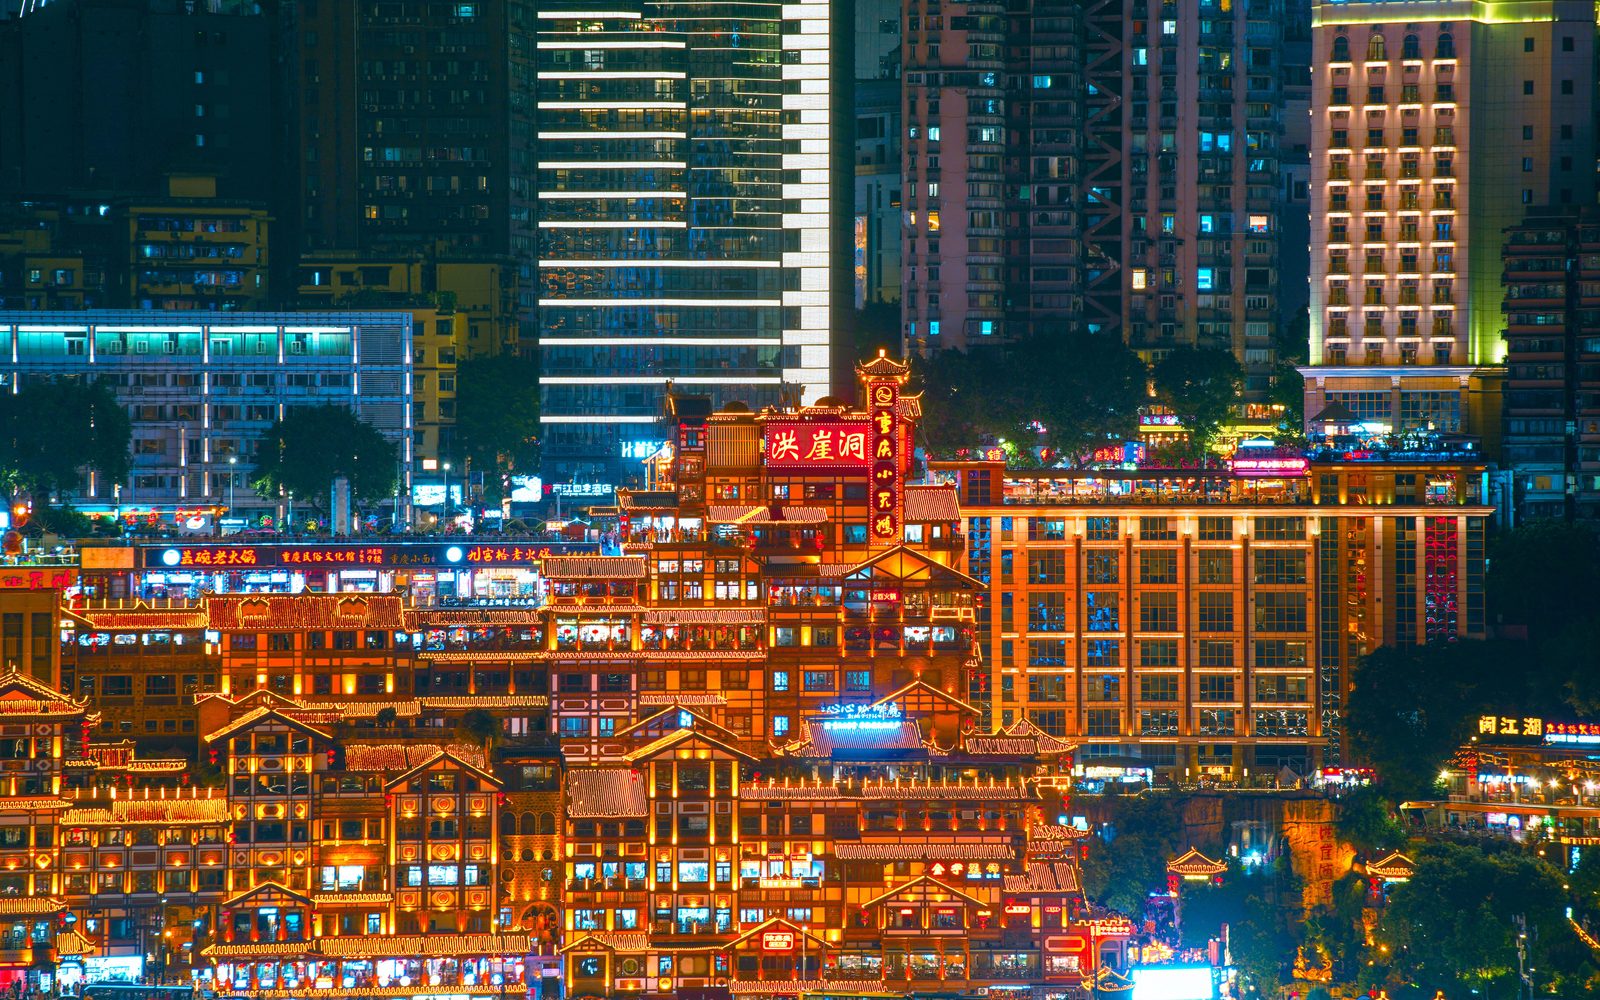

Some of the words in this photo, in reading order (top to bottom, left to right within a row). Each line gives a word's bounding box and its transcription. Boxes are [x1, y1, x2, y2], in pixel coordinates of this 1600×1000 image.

[771, 429, 865, 462] 洪崖洞
[180, 549, 257, 565] 盖碗老火锅
[467, 546, 552, 562] 九宫格老火锅
